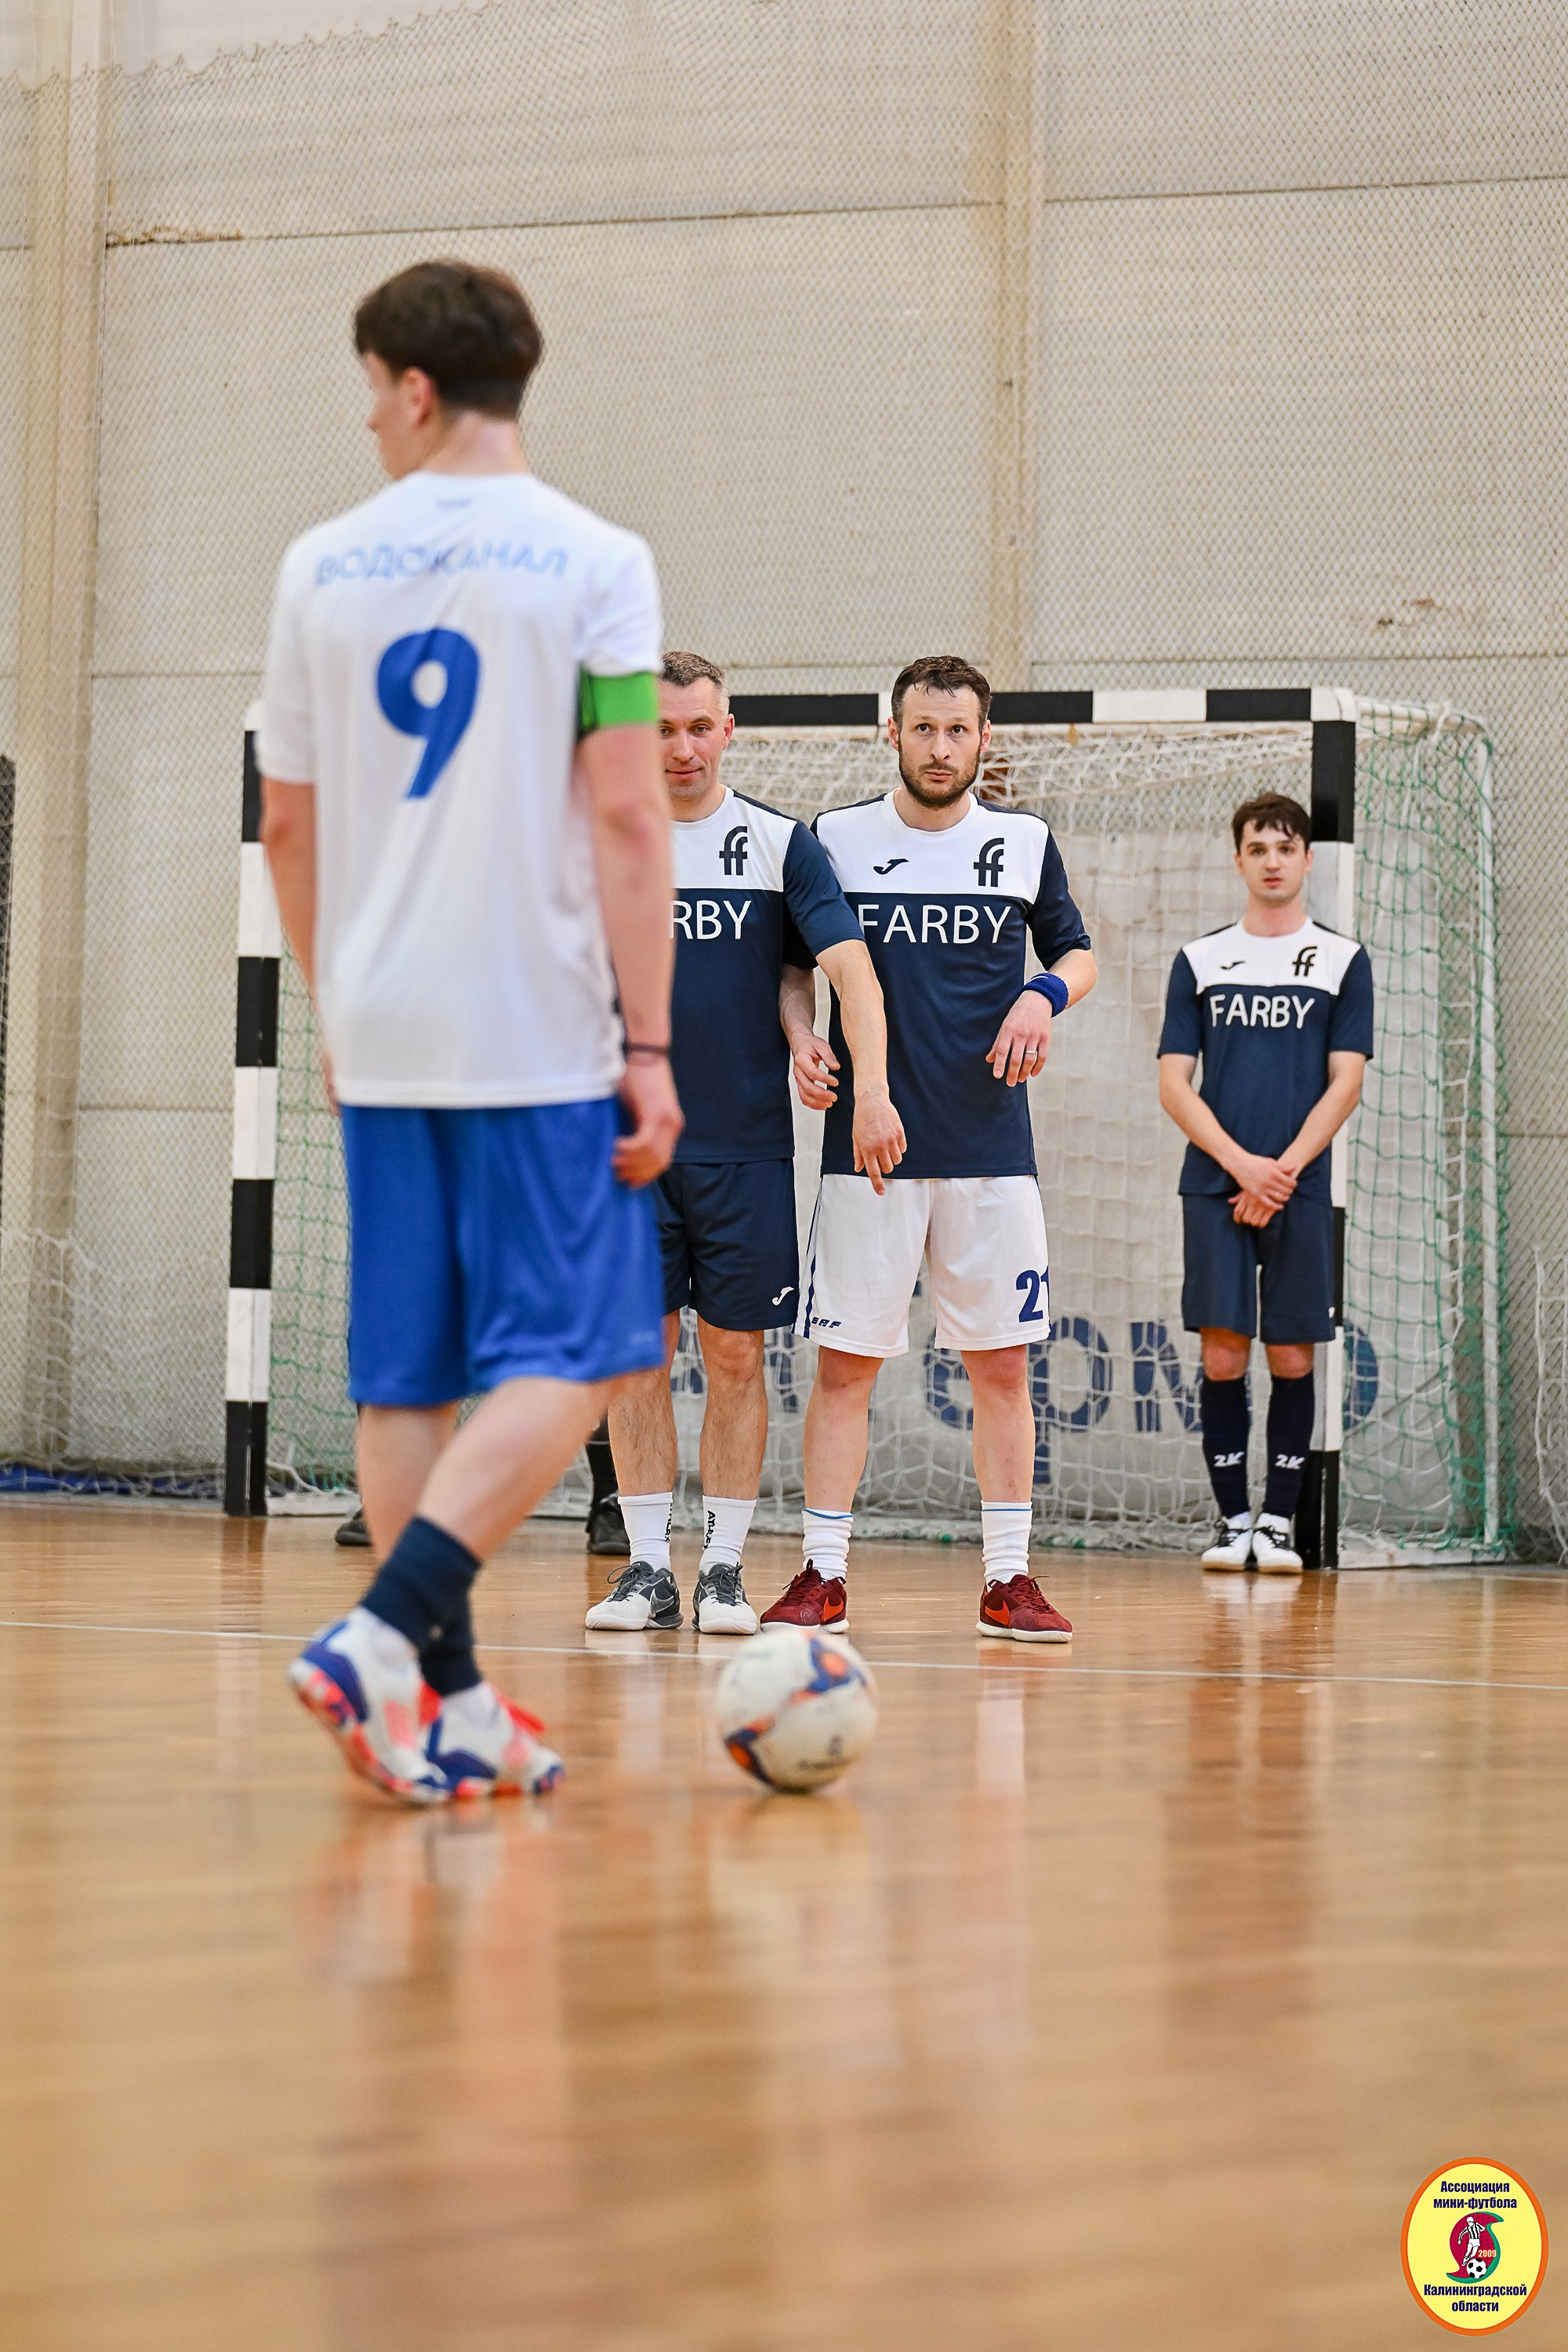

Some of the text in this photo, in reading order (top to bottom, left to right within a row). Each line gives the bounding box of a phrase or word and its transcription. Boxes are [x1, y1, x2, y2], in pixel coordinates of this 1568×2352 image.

[314, 541, 568, 586] ВОДОКАНАЛ
[376, 628, 480, 798] 9
[670, 900, 751, 940] RBY
[858, 904, 1011, 944] FARBY
[1210, 993, 1316, 1029] FARBY
